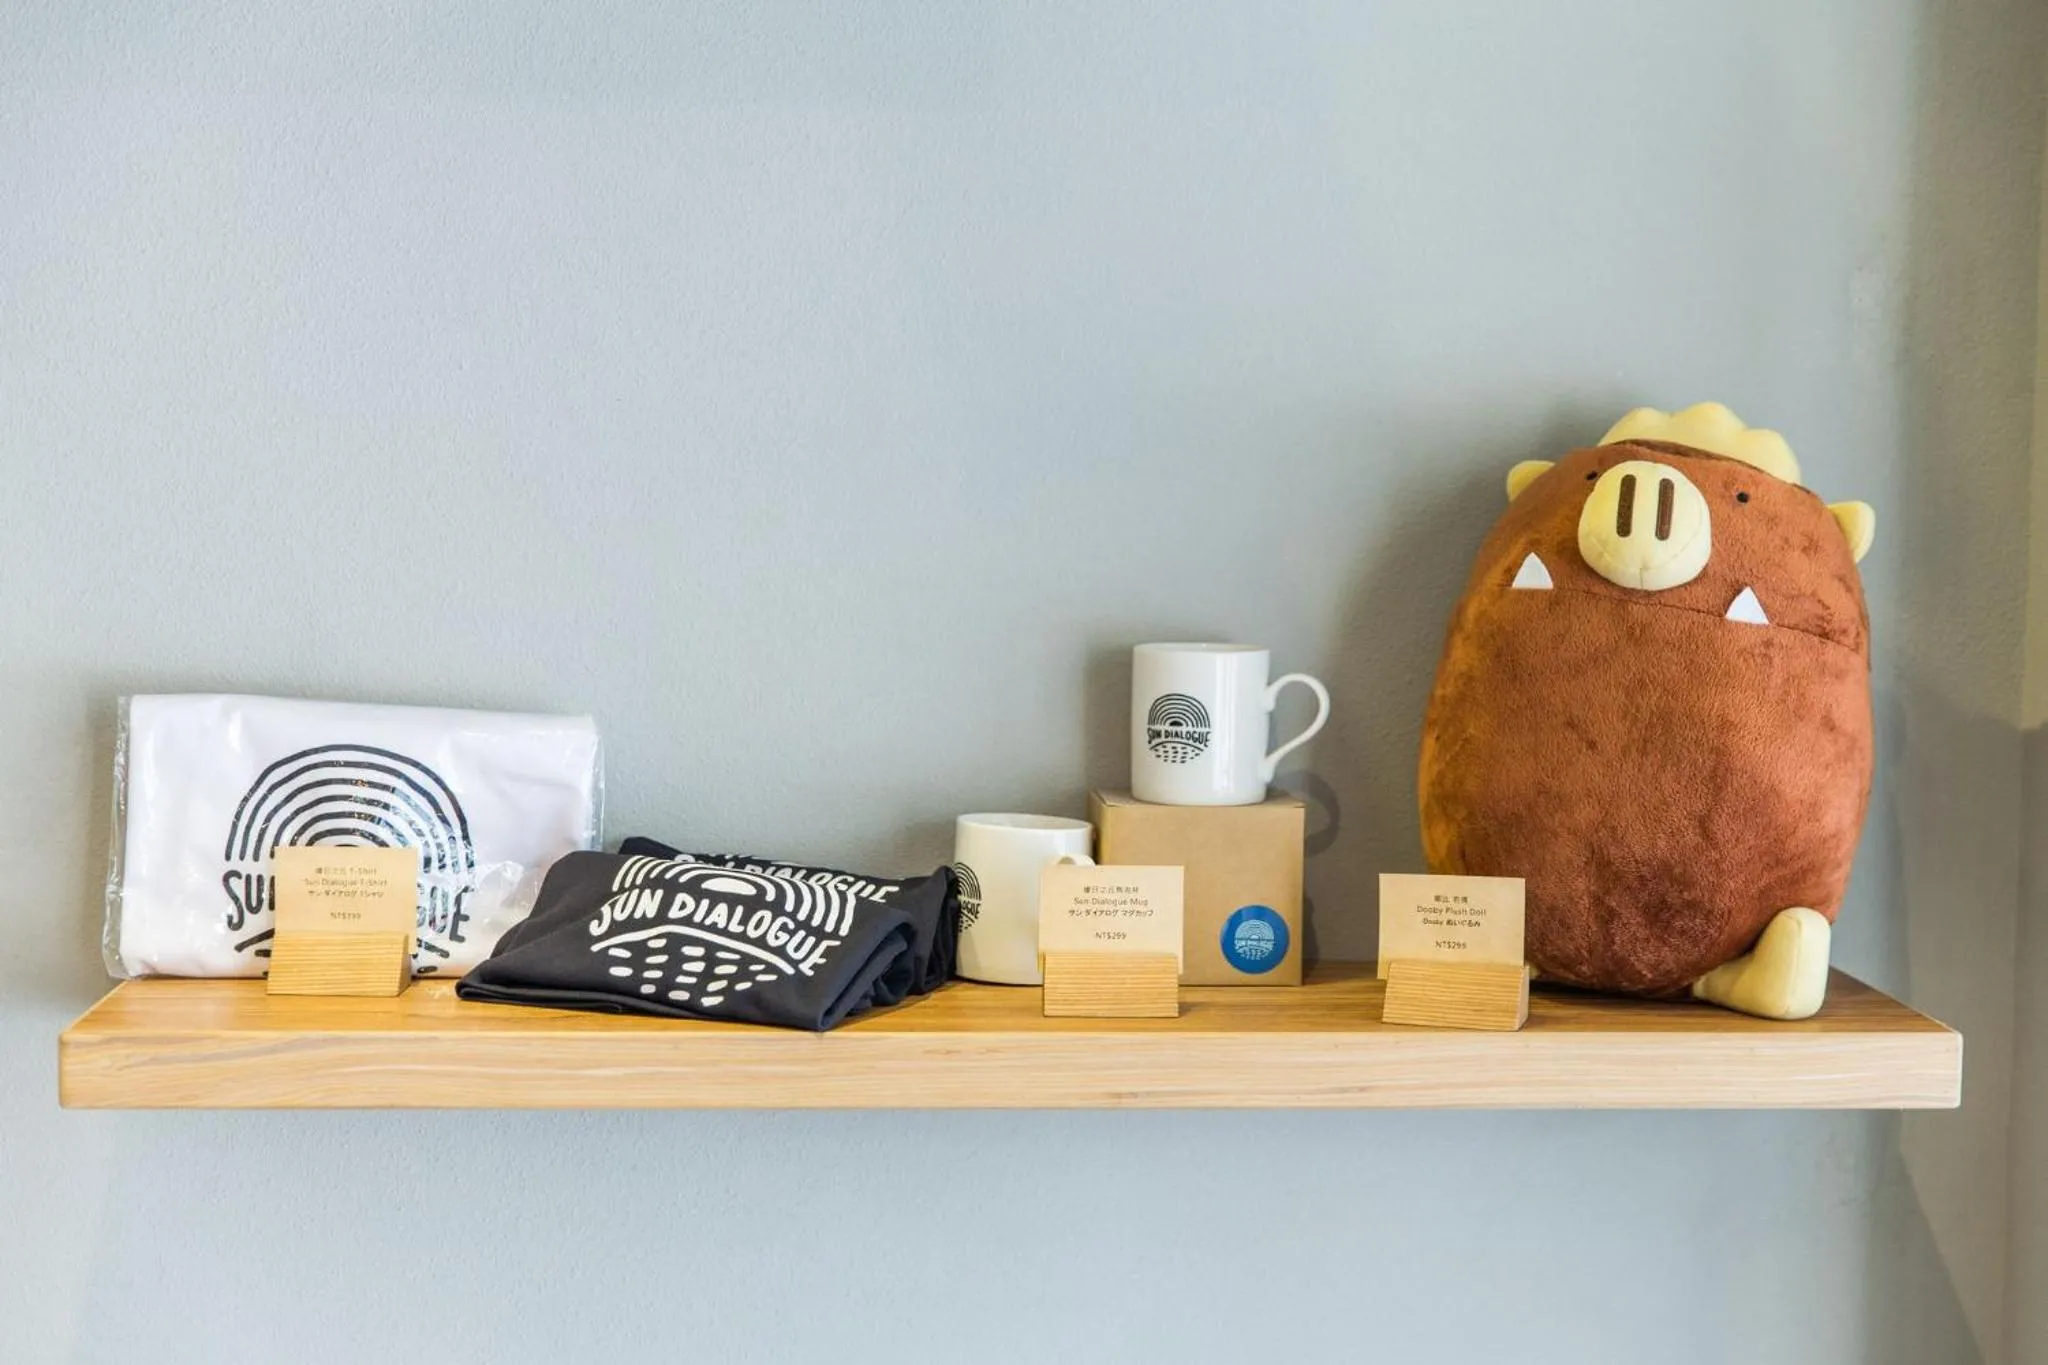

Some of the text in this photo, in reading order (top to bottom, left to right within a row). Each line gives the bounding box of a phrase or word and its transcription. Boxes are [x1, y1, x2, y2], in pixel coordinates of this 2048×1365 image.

[1147, 727, 1211, 748] SUN DIALOGUE
[322, 878, 357, 888] Dialogue
[1074, 897, 1148, 907] Sun Dialogue Mug
[1469, 908, 1487, 917] Doll
[589, 888, 841, 976] SUN DIALOGUE
